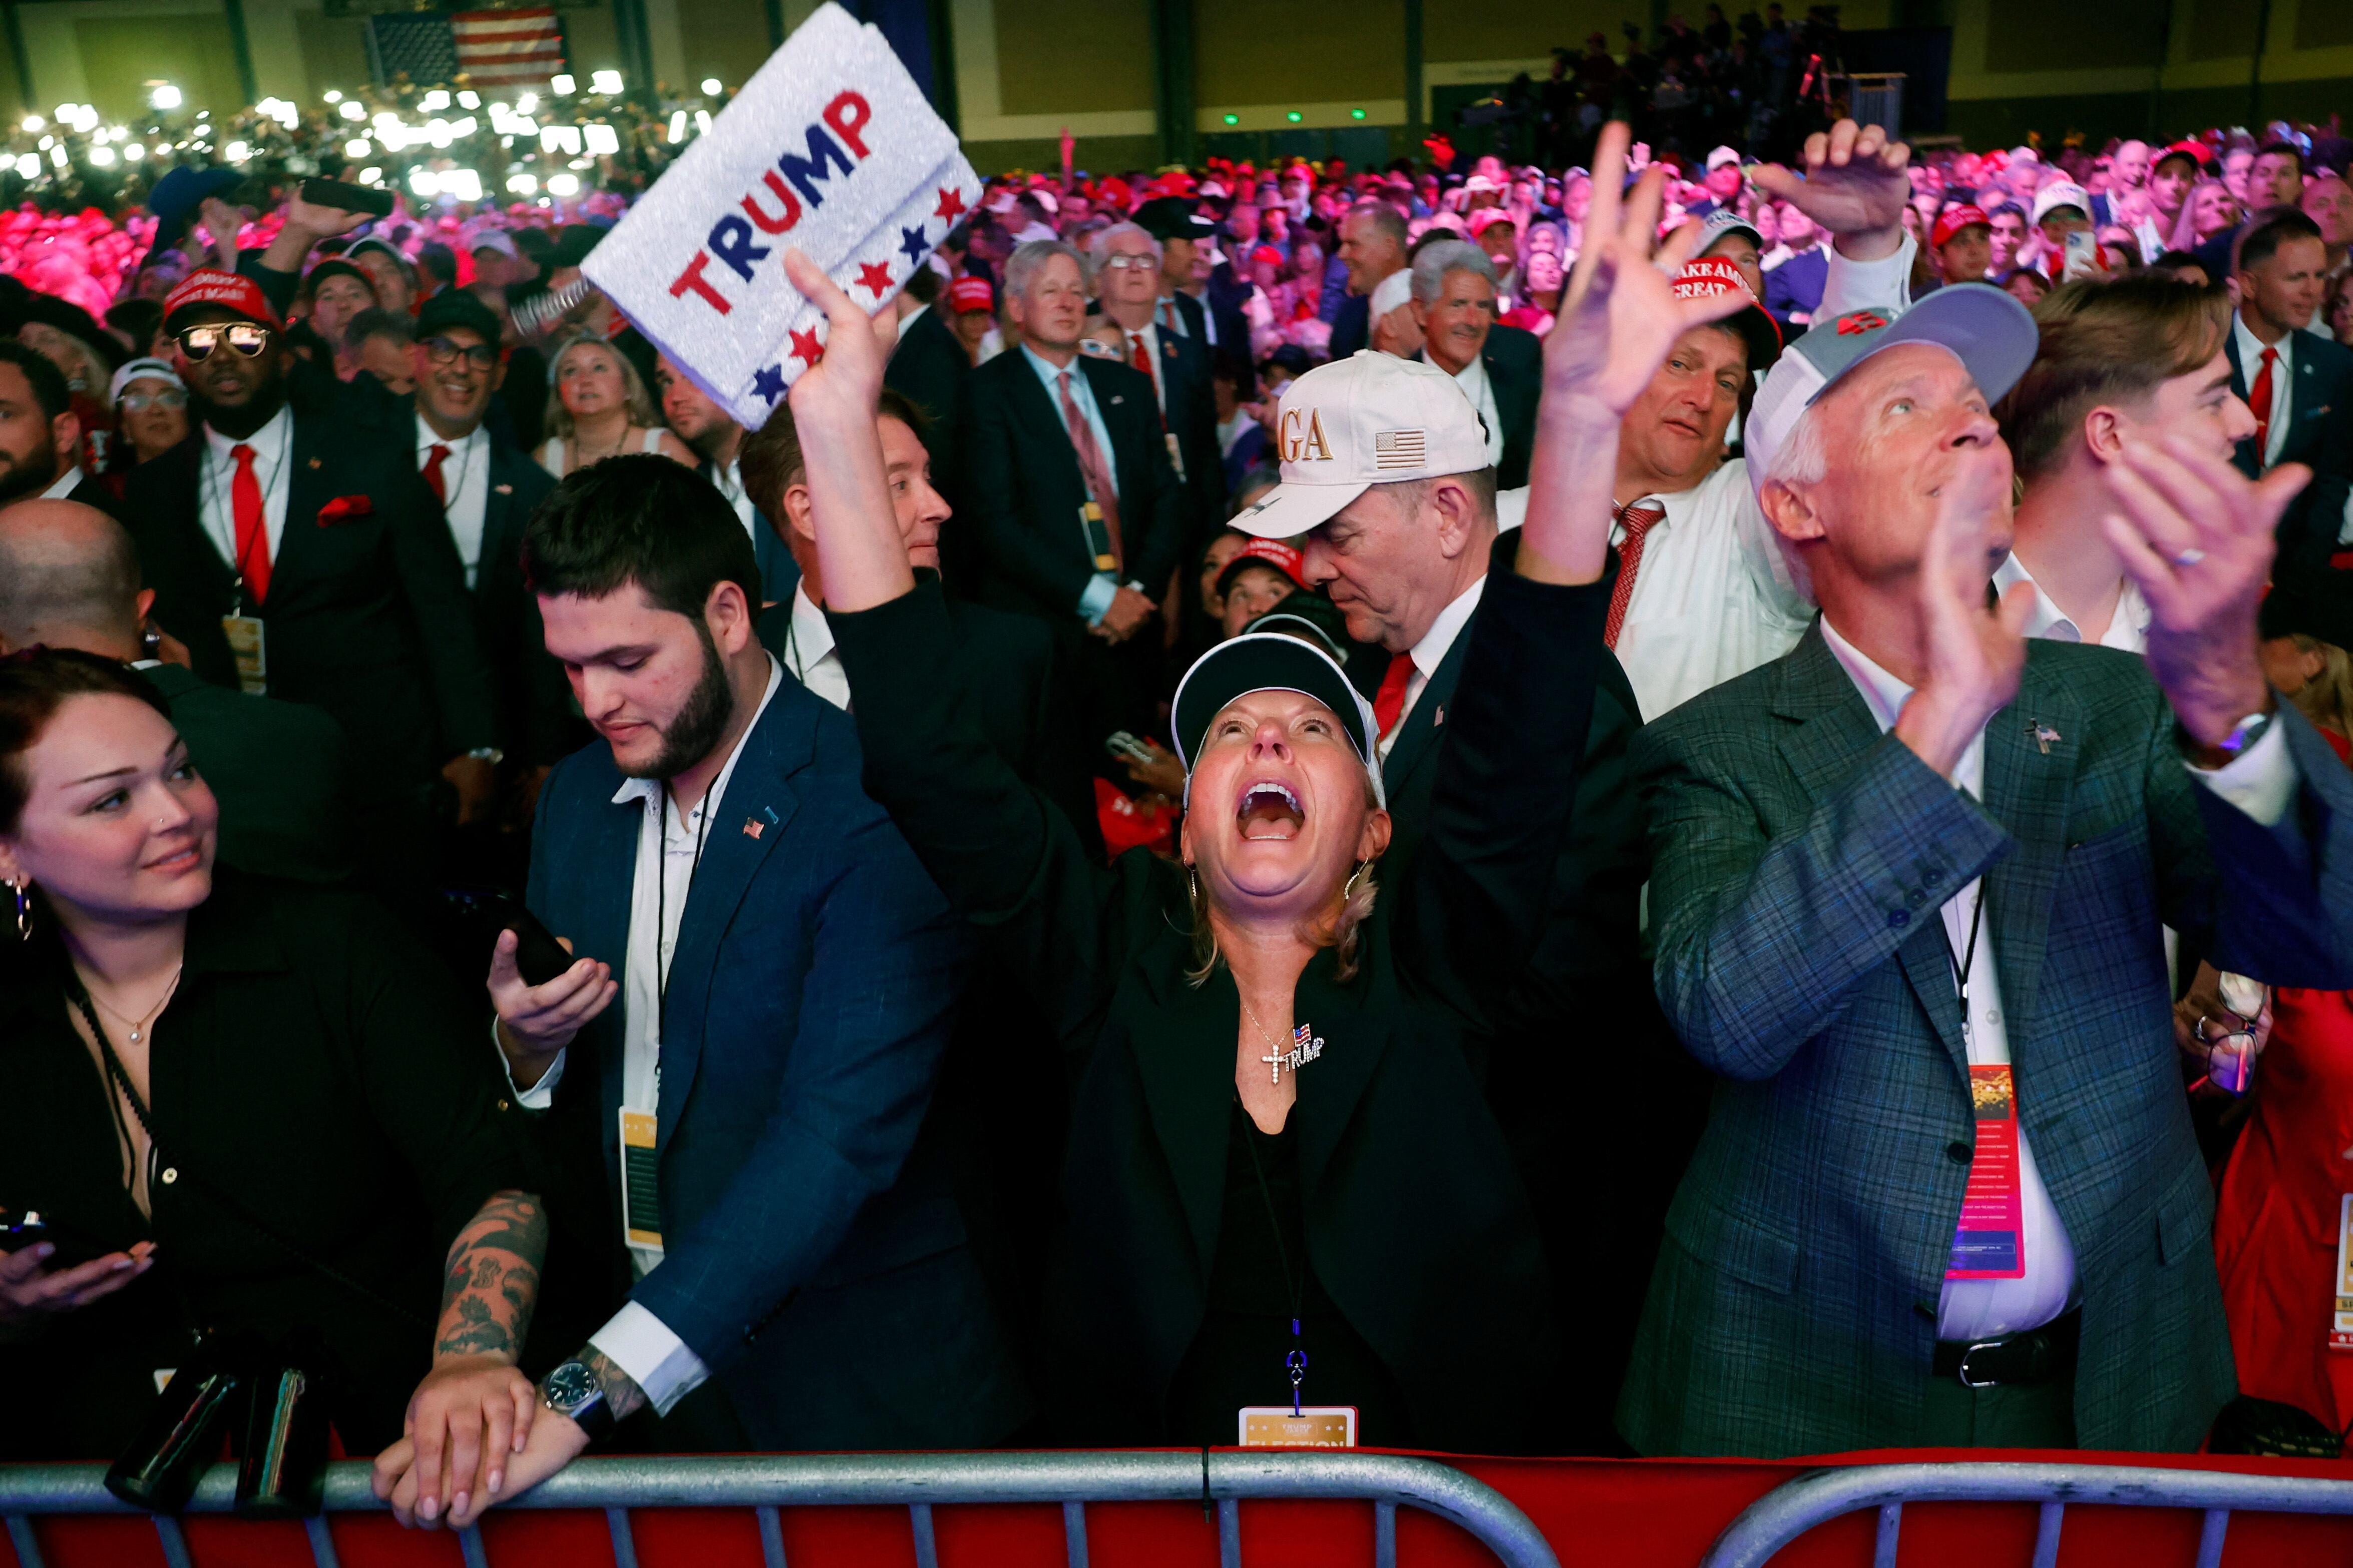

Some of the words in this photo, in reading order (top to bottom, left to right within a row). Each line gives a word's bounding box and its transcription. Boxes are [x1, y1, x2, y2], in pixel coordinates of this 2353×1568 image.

[669, 89, 871, 316] TRUMP
[1677, 263, 1713, 278] AKE
[1283, 1037, 1324, 1072] TRUMP
